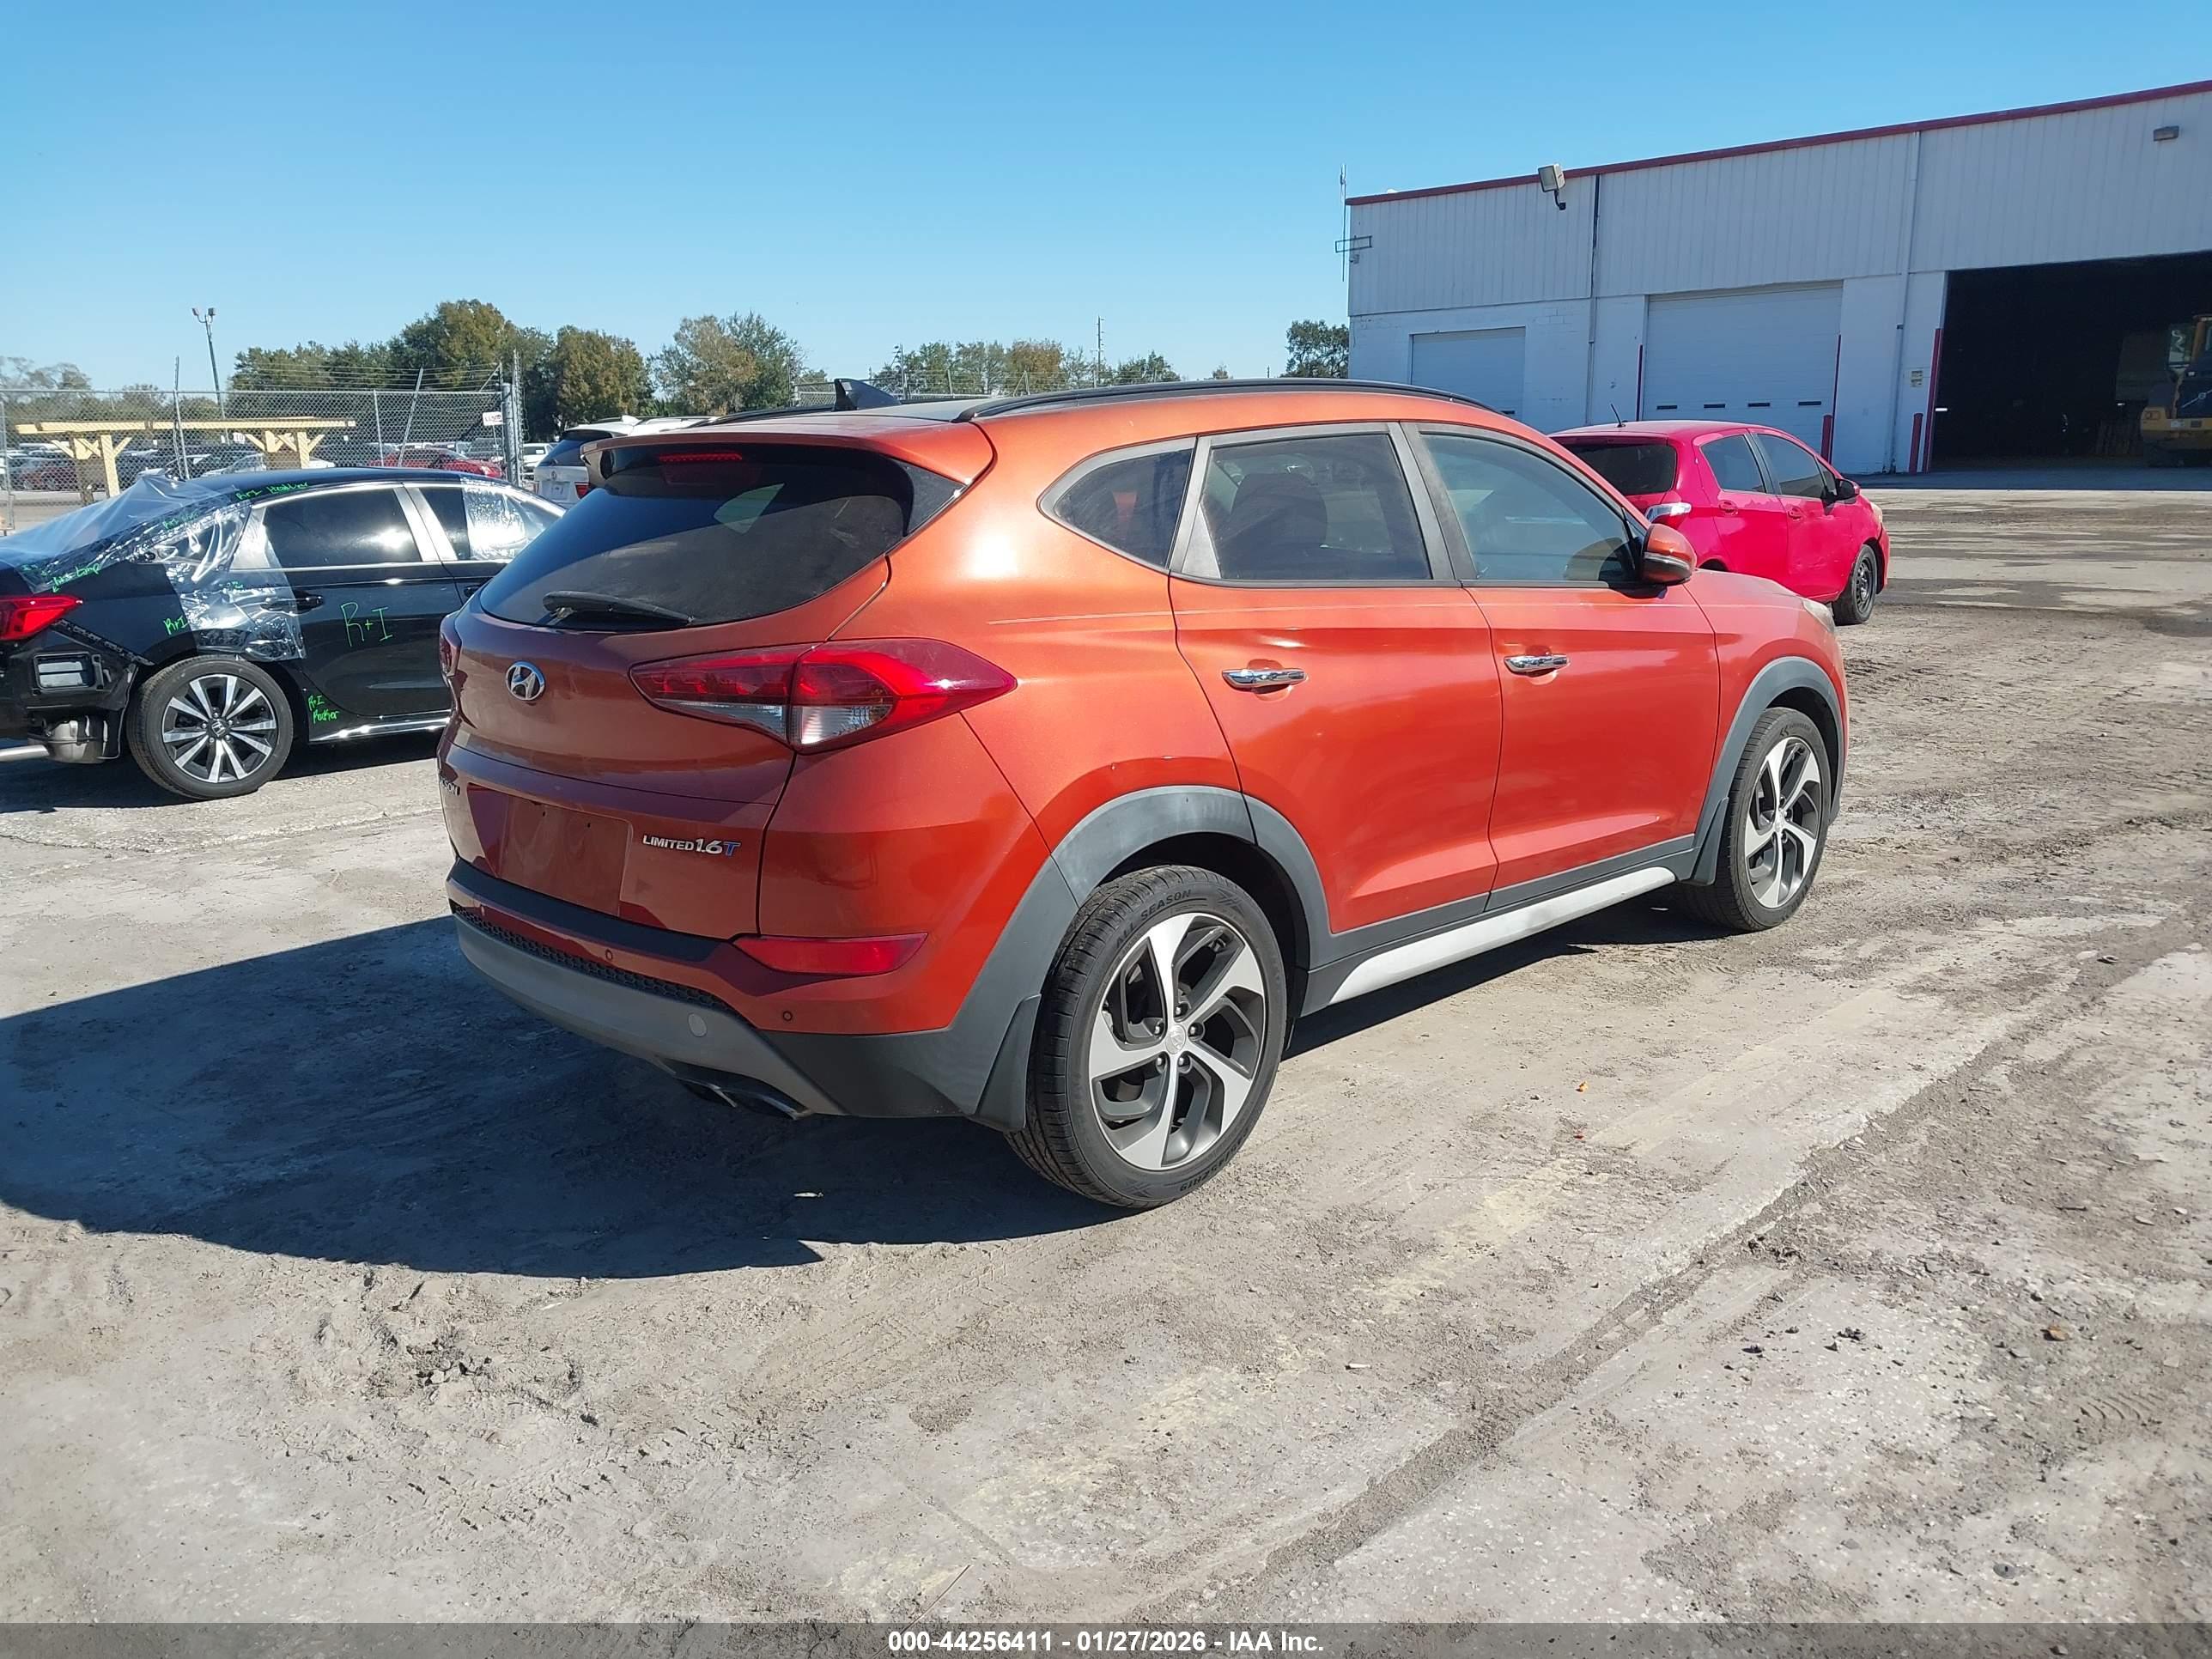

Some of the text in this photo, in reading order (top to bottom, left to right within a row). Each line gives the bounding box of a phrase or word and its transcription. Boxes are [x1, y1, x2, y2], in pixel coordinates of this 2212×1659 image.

[340, 601, 393, 647] R+I
[642, 835, 695, 852] LIMITED
[1140, 889, 1192, 921] SEASON
